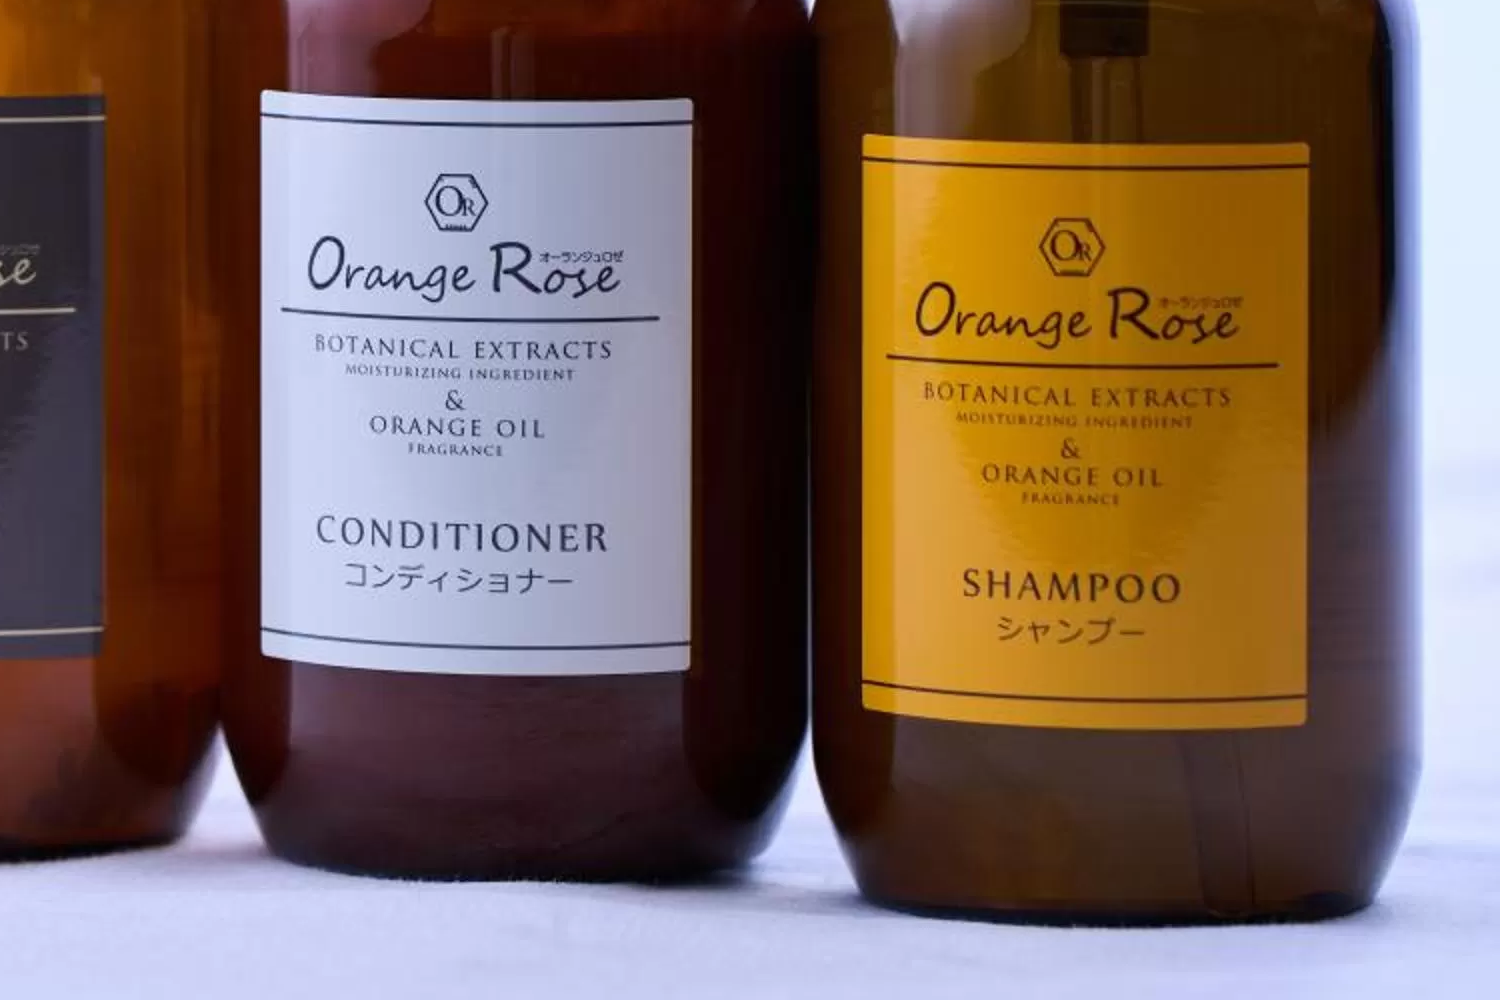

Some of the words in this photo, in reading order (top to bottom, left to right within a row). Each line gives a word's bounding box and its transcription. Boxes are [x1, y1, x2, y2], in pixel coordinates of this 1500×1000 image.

[434, 185, 477, 218] OR
[307, 235, 476, 304] Orange
[489, 241, 621, 300] Rose
[539, 249, 625, 264] オーランジュロゼ
[915, 281, 1093, 350] Orange
[1107, 286, 1240, 345] Rose
[314, 333, 461, 359] BOTANICAL
[474, 340, 613, 361] EXTRACTS
[345, 363, 461, 380] MOISTURIZING
[469, 368, 576, 382] INGREDIENT
[445, 389, 465, 411] &
[923, 380, 1076, 407] BOTANICAL
[1091, 387, 1232, 409] EXTRACTS
[369, 415, 482, 438] ORANGE
[496, 418, 546, 439] OIL
[955, 411, 1078, 429] MOISTURIZING
[1085, 415, 1193, 430] INGREDIENT
[407, 442, 504, 457] FRAGRANCE
[1060, 438, 1081, 460] &
[981, 462, 1100, 487] ORANGE
[1112, 467, 1165, 489] OIL
[1020, 491, 1121, 507] FRAGRANCE
[315, 515, 608, 553] CONDITIONER
[344, 563, 574, 594] コンディショナー
[962, 567, 1182, 604] SHAMPOO
[997, 616, 1146, 646] シャンプー
